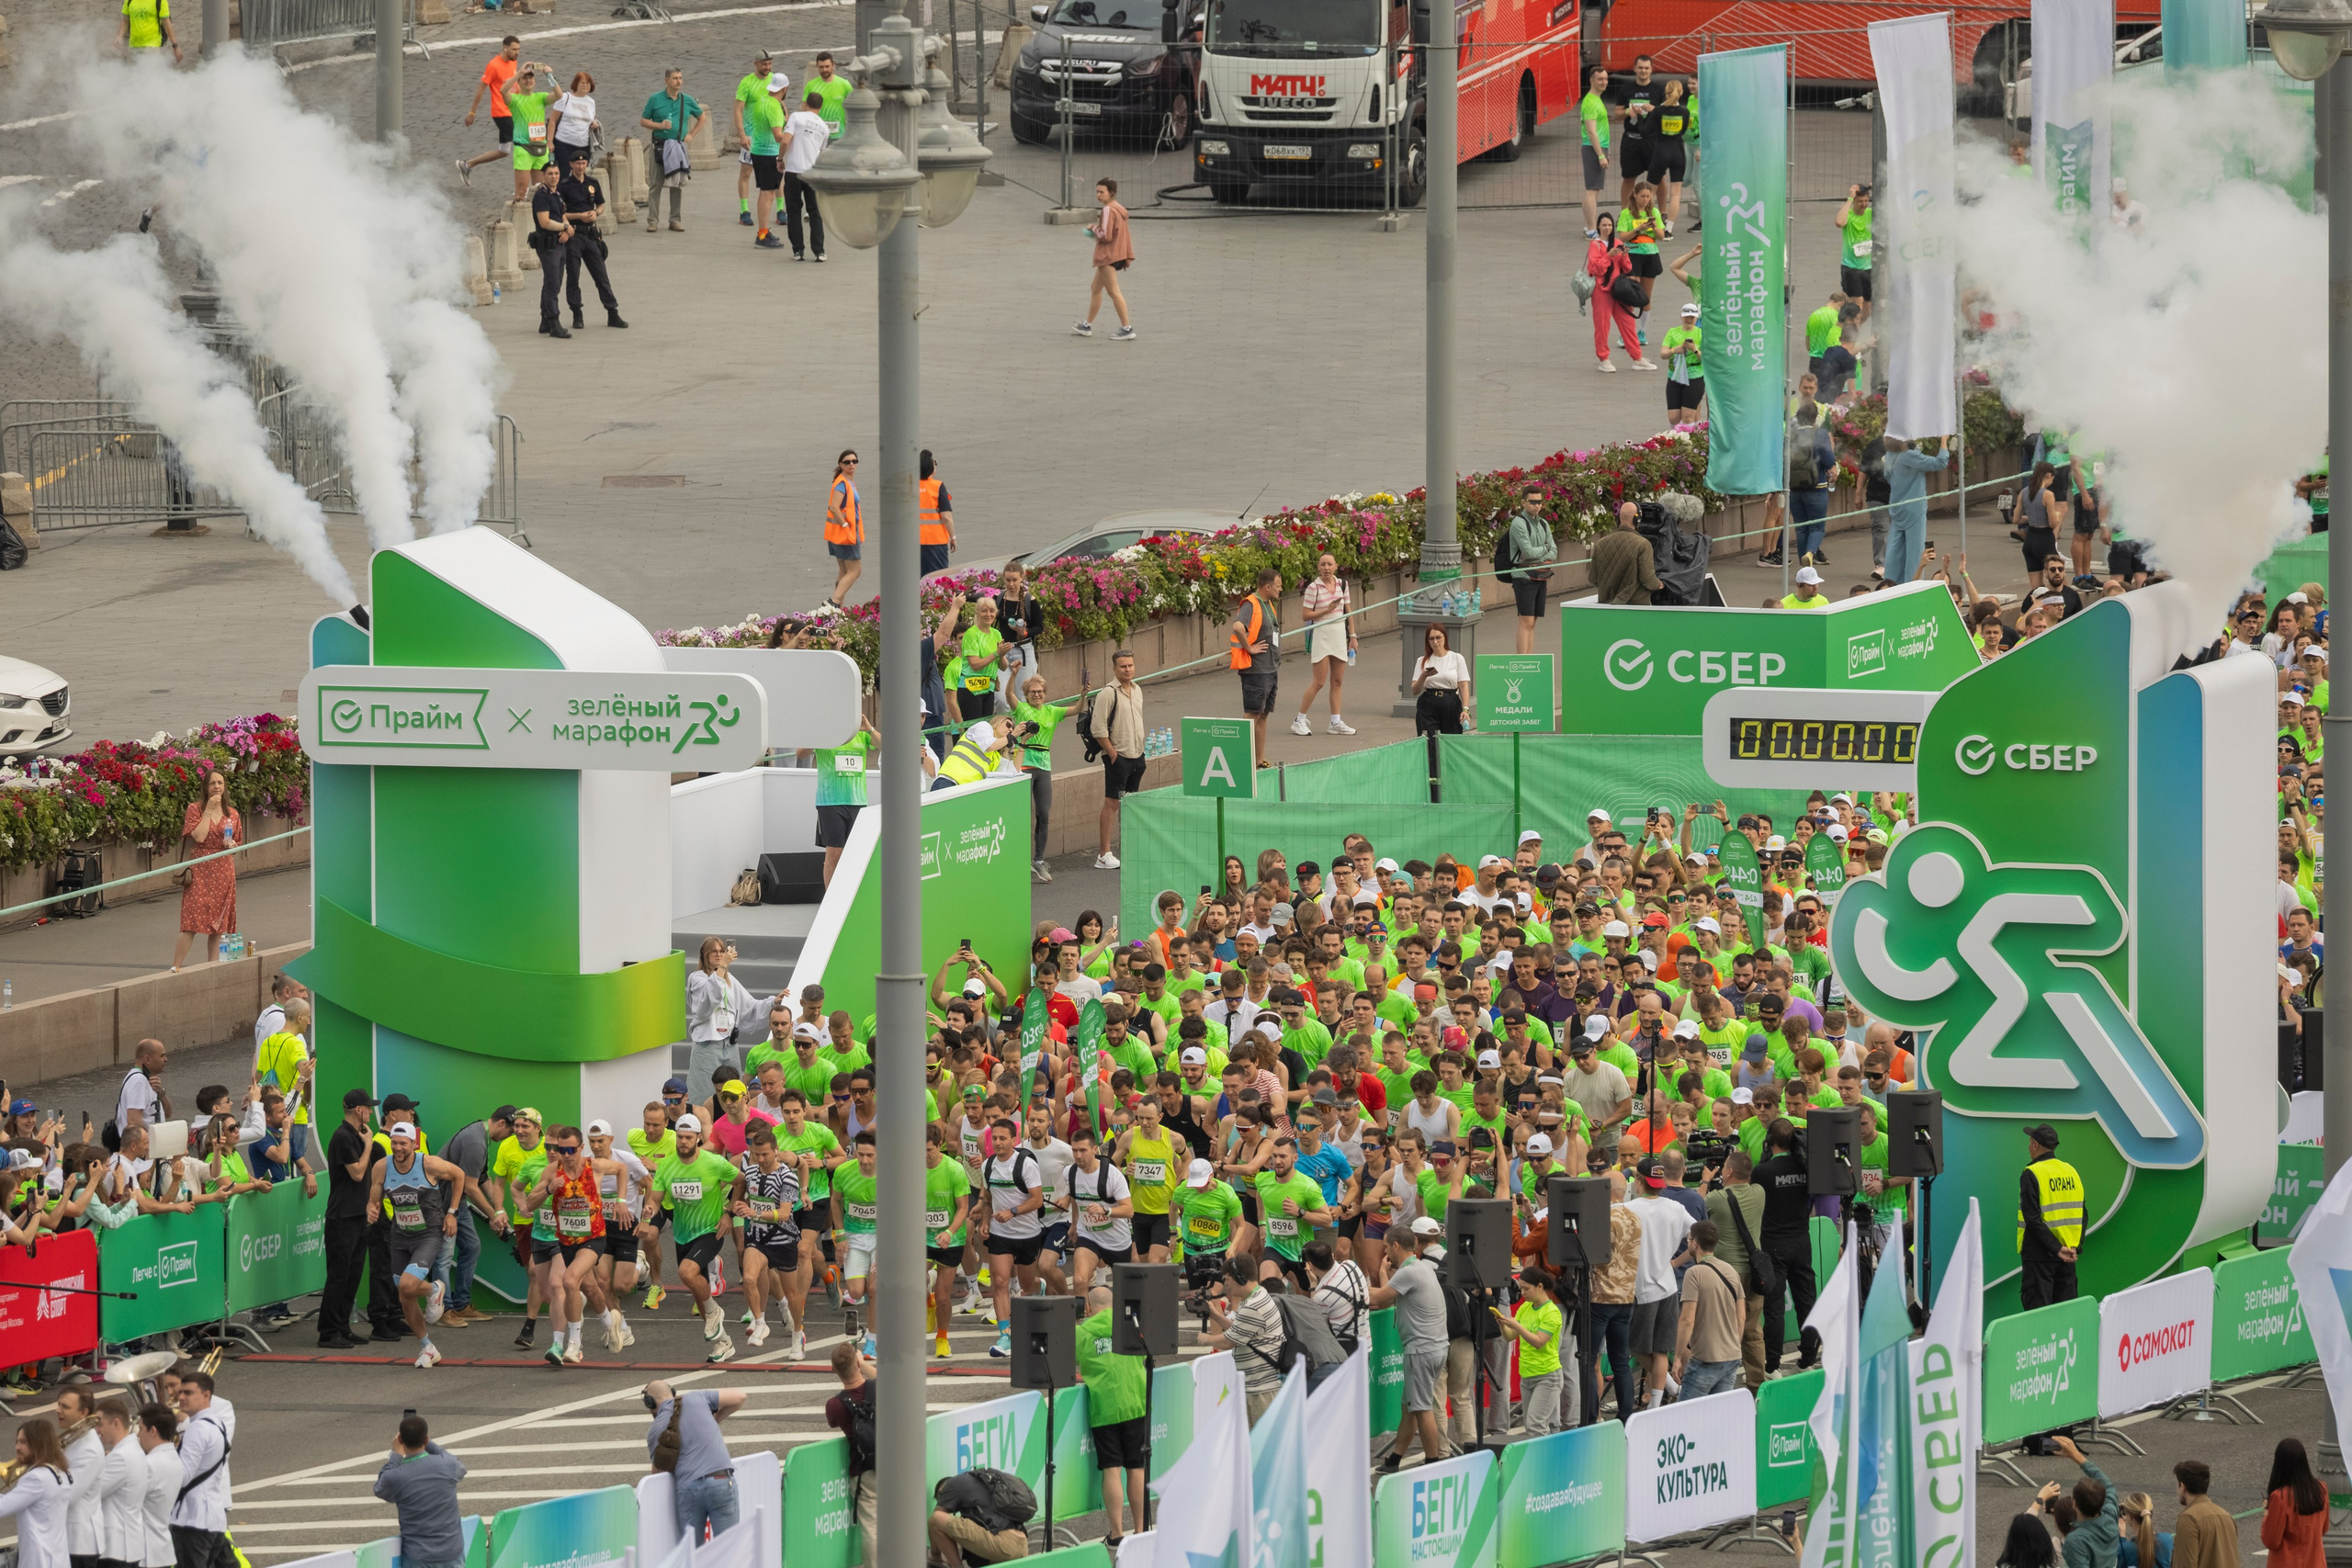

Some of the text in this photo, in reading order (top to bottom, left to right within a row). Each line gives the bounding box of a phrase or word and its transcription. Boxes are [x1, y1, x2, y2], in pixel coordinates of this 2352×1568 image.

[1250, 74, 1326, 96] МАТЧ!
[1259, 96, 1317, 109] IVECO
[2058, 142, 2077, 215] райм
[1720, 242, 1743, 356] зелёный
[1743, 250, 1769, 370] марафон
[1901, 619, 1926, 640] зелёный
[1860, 642, 1880, 665] Прайм
[1897, 638, 1924, 660] марафон
[1668, 649, 1787, 685] СБЕР
[568, 694, 683, 718] зелёный
[370, 704, 462, 734] Прайм
[552, 721, 672, 747] марафон
[845, 758, 855, 766] 10
[1200, 746, 1237, 788] А
[2005, 743, 2098, 772] СБЕР
[960, 820, 990, 844] зелёный
[921, 846, 934, 866] айм
[956, 842, 989, 865] марафон
[1138, 1166, 1161, 1175] 7347
[673, 1185, 700, 1194] 11291
[2049, 1177, 2075, 1191] ОХРАНА
[399, 1213, 420, 1223] 6975
[563, 1218, 586, 1226] 7608
[854, 1206, 876, 1215] 7045
[296, 1214, 322, 1236] зелёный
[1193, 1219, 1220, 1232] 10860
[1272, 1221, 1294, 1231] 8596
[254, 1234, 281, 1261] СБЕР
[292, 1235, 320, 1258] марафон
[132, 1254, 192, 1284] Легче с Прайм
[2244, 1276, 2289, 1312] зелёный
[51, 1297, 67, 1318] СПОРТ
[2238, 1309, 2284, 1346] марафон
[2015, 1333, 2056, 1371] зелёный
[2133, 1319, 2195, 1365] самокат
[1382, 1348, 1404, 1368] зелёны
[2009, 1371, 2052, 1402] марафон
[956, 1410, 1017, 1473] БЕГИ
[1780, 1433, 1801, 1454] Прайм
[1657, 1461, 1728, 1505] КУЛЬТУРА
[1412, 1472, 1470, 1540] БЕГИ
[1525, 1479, 1603, 1515] #создаваябудущее
[1412, 1533, 1462, 1562] НАСТОЯЩИМ
